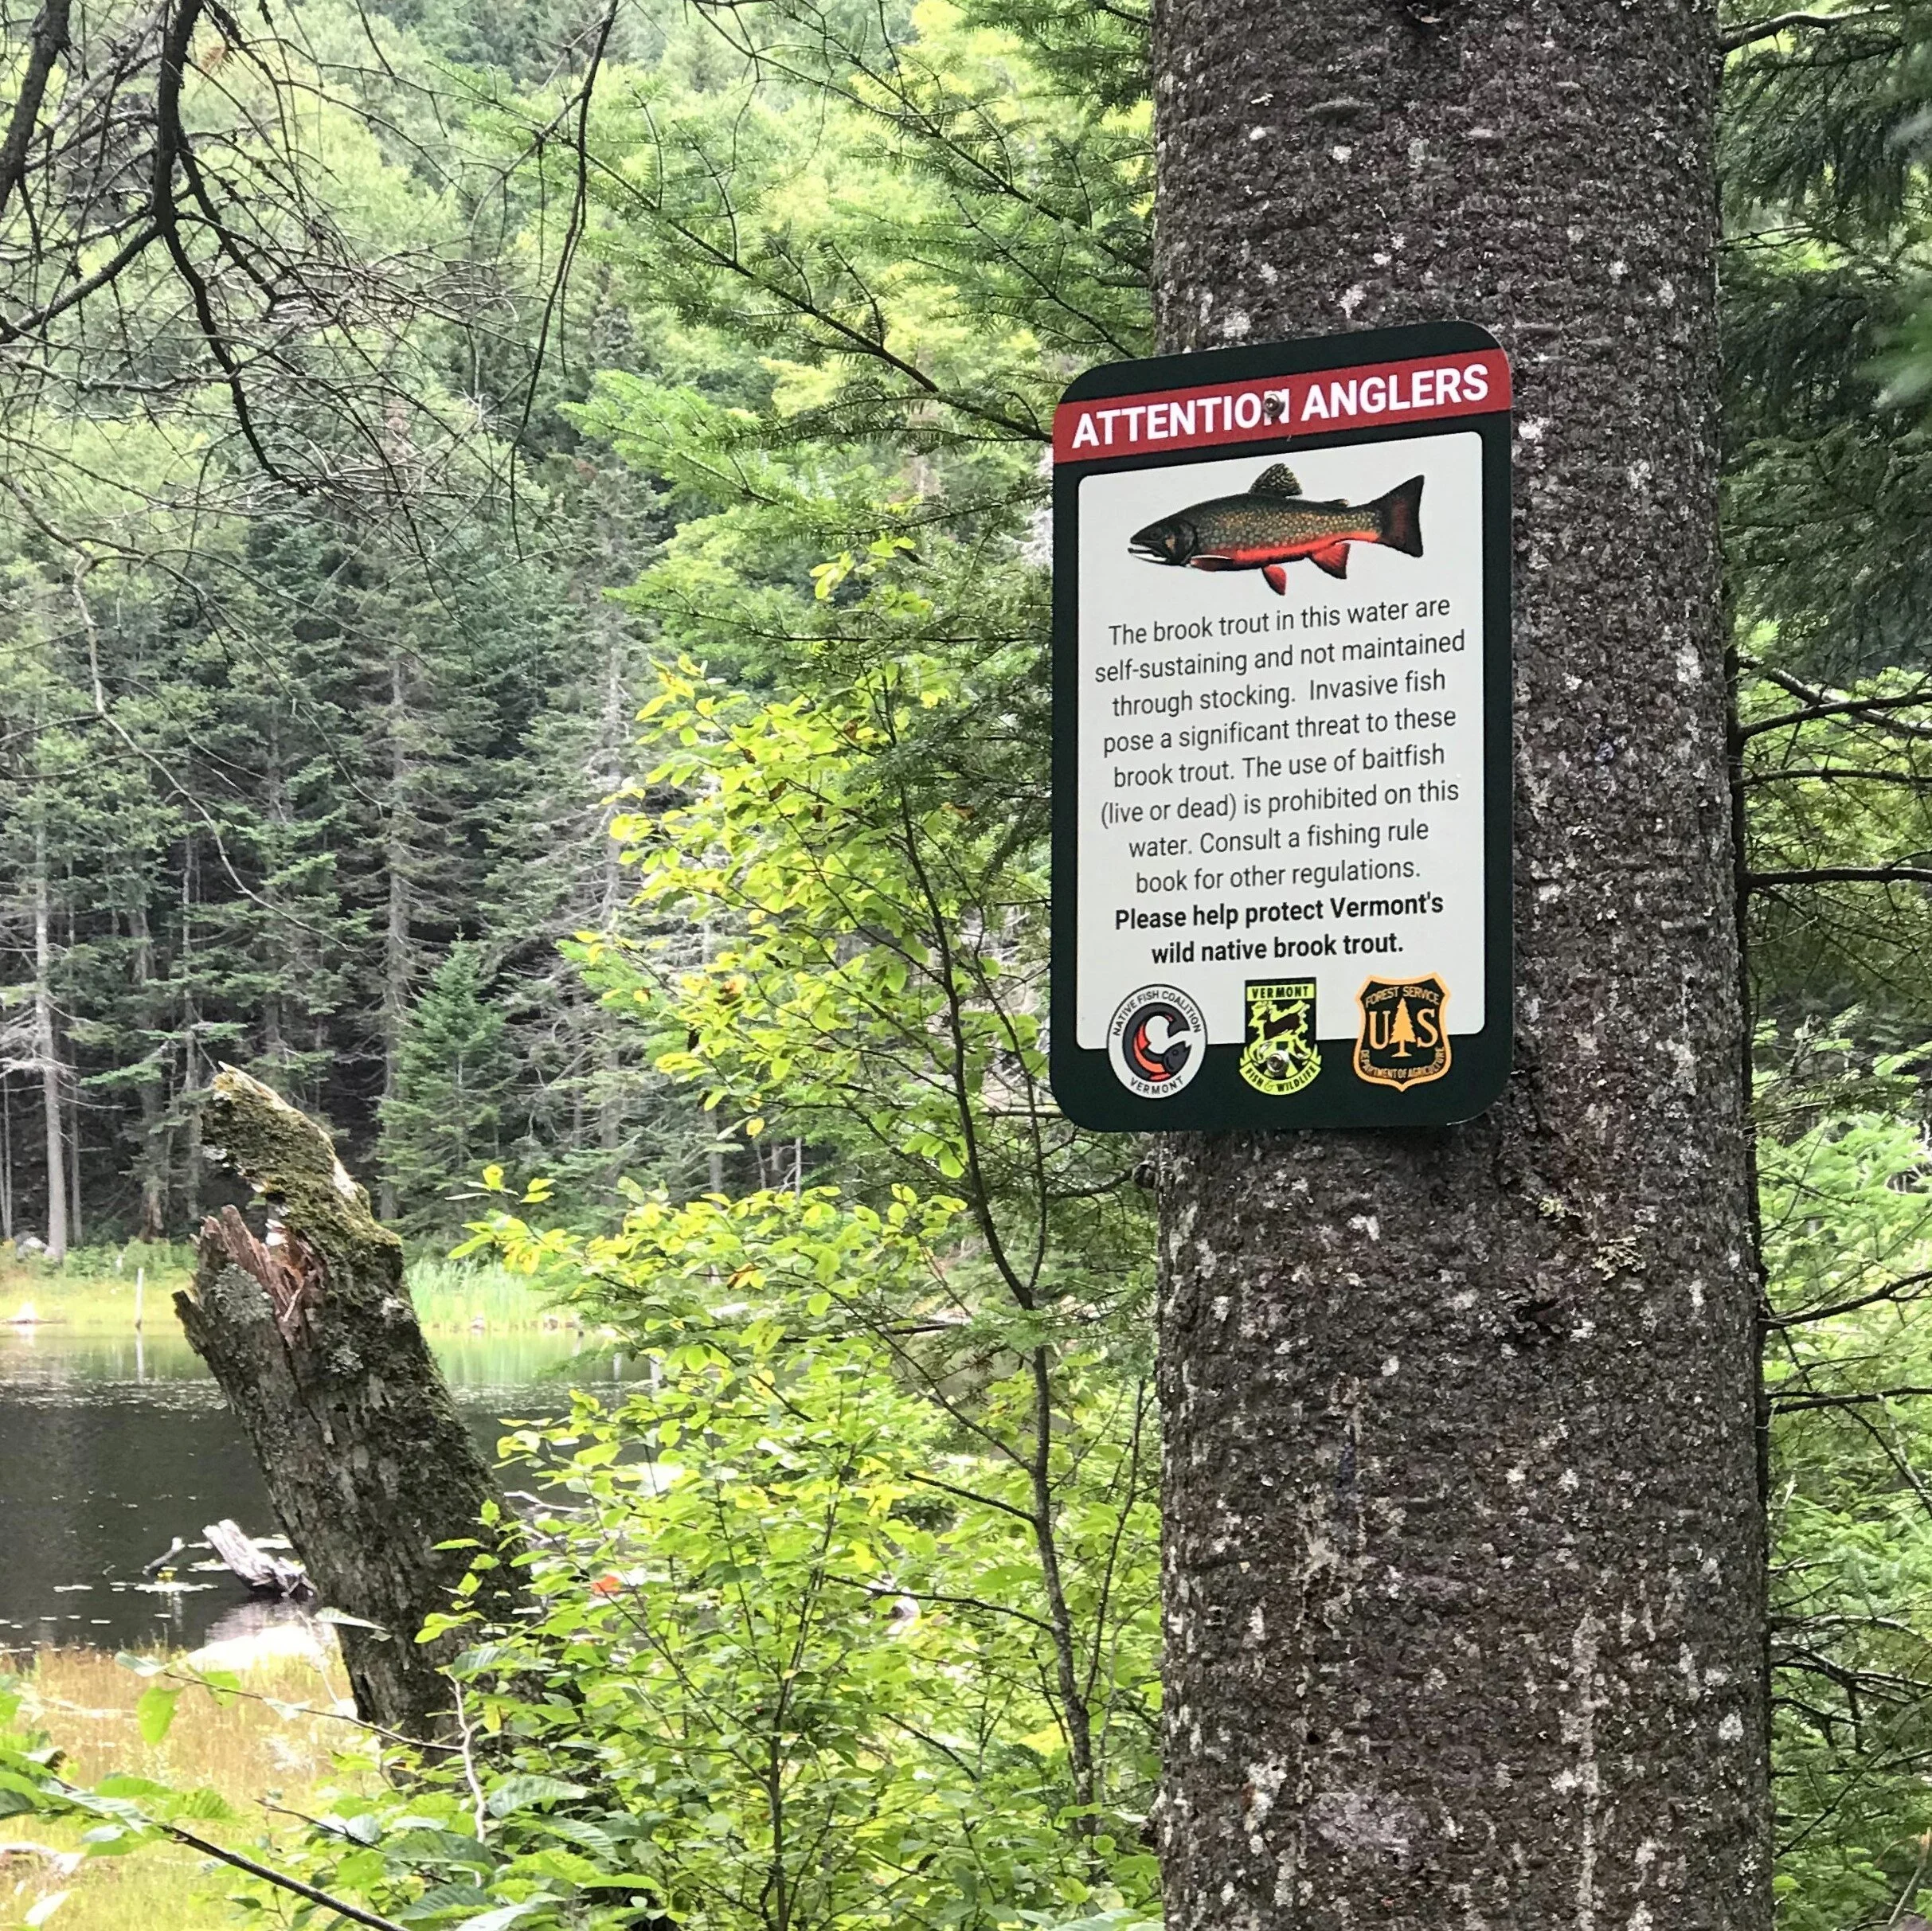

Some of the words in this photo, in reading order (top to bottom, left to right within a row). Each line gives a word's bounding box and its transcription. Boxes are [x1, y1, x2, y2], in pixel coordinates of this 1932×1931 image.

[1300, 363, 1488, 421] ANGLERS
[1108, 623, 1147, 646] The
[1153, 616, 1213, 642] brook
[1218, 612, 1269, 636] trout
[1277, 610, 1294, 631] in
[1300, 605, 1340, 629] this
[1347, 601, 1409, 624] water
[1415, 599, 1451, 618] are
[1095, 651, 1247, 683] self-sustaining
[1254, 644, 1293, 670] and
[1300, 643, 1336, 665] not
[1342, 628, 1465, 662] maintained
[1112, 690, 1193, 718] through
[1199, 684, 1296, 709] stocking.
[1310, 674, 1398, 701] Invasive
[1405, 668, 1445, 693] fish
[1104, 733, 1154, 759] pose
[1160, 732, 1172, 749] a
[1179, 720, 1290, 752] significant
[1296, 713, 1360, 738] threat
[1366, 713, 1388, 733] to
[1394, 707, 1457, 731] these
[1114, 763, 1174, 788] brook
[1178, 760, 1234, 784] trout.
[1242, 756, 1282, 778] The
[1289, 756, 1327, 776] use
[1333, 748, 1356, 772] of
[1363, 742, 1445, 770] baitfish
[1101, 802, 1144, 830] (live
[1149, 803, 1171, 821] or
[1176, 793, 1237, 822] dead)
[1244, 793, 1261, 815] is
[1269, 784, 1377, 819] prohibited
[1384, 787, 1411, 805] on
[1418, 780, 1459, 803] this
[1128, 837, 1193, 858] water.
[1200, 827, 1281, 854] Consult
[1288, 831, 1300, 848] a
[1307, 823, 1380, 849] fishing
[1388, 818, 1429, 842] rule
[1136, 870, 1188, 893] book
[1194, 867, 1224, 890] for
[1230, 865, 1286, 888] other
[1293, 858, 1421, 889] regulations.
[1115, 908, 1187, 931] Please
[1193, 902, 1239, 930] help
[1246, 900, 1324, 929] protect
[1329, 891, 1444, 919] Vermont's
[1151, 940, 1195, 964] wild
[1201, 938, 1268, 962] native
[1273, 933, 1338, 959] brook
[1343, 932, 1403, 955] trout.
[1113, 999, 1137, 1036] NATIVE
[1136, 990, 1160, 1004] FISH
[1161, 990, 1202, 1034] COALITION
[1251, 985, 1309, 999] VERMONT
[1365, 986, 1400, 1008] FOREST
[1402, 986, 1441, 1006] SERVICE
[1129, 1075, 1185, 1095] VERMONT
[1244, 1066, 1264, 1088] FISH
[1276, 1065, 1318, 1093] WILDLIFE
